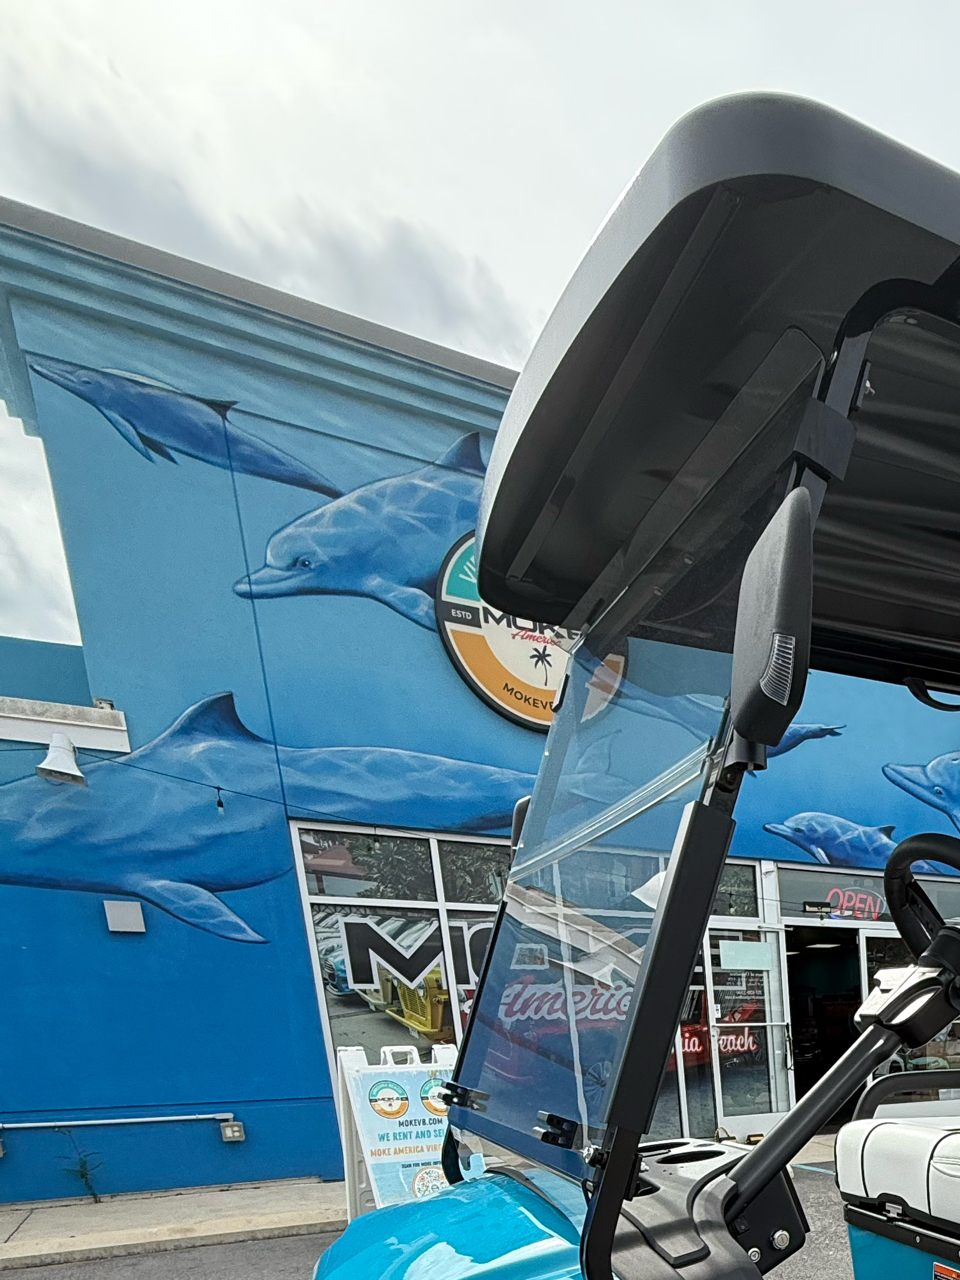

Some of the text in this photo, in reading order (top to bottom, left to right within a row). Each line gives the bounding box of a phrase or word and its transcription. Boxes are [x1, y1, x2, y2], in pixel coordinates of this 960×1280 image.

[451, 608, 473, 620] ESTD
[825, 887, 882, 920] OPEN
[718, 1026, 757, 1053] each
[398, 1118, 443, 1128] MOKEVB.COM
[378, 1132, 390, 1142] WE
[392, 1131, 412, 1141] RENT
[415, 1129, 431, 1139] AND
[370, 1147, 392, 1157] MOKE
[393, 1145, 424, 1155] AMERICA
